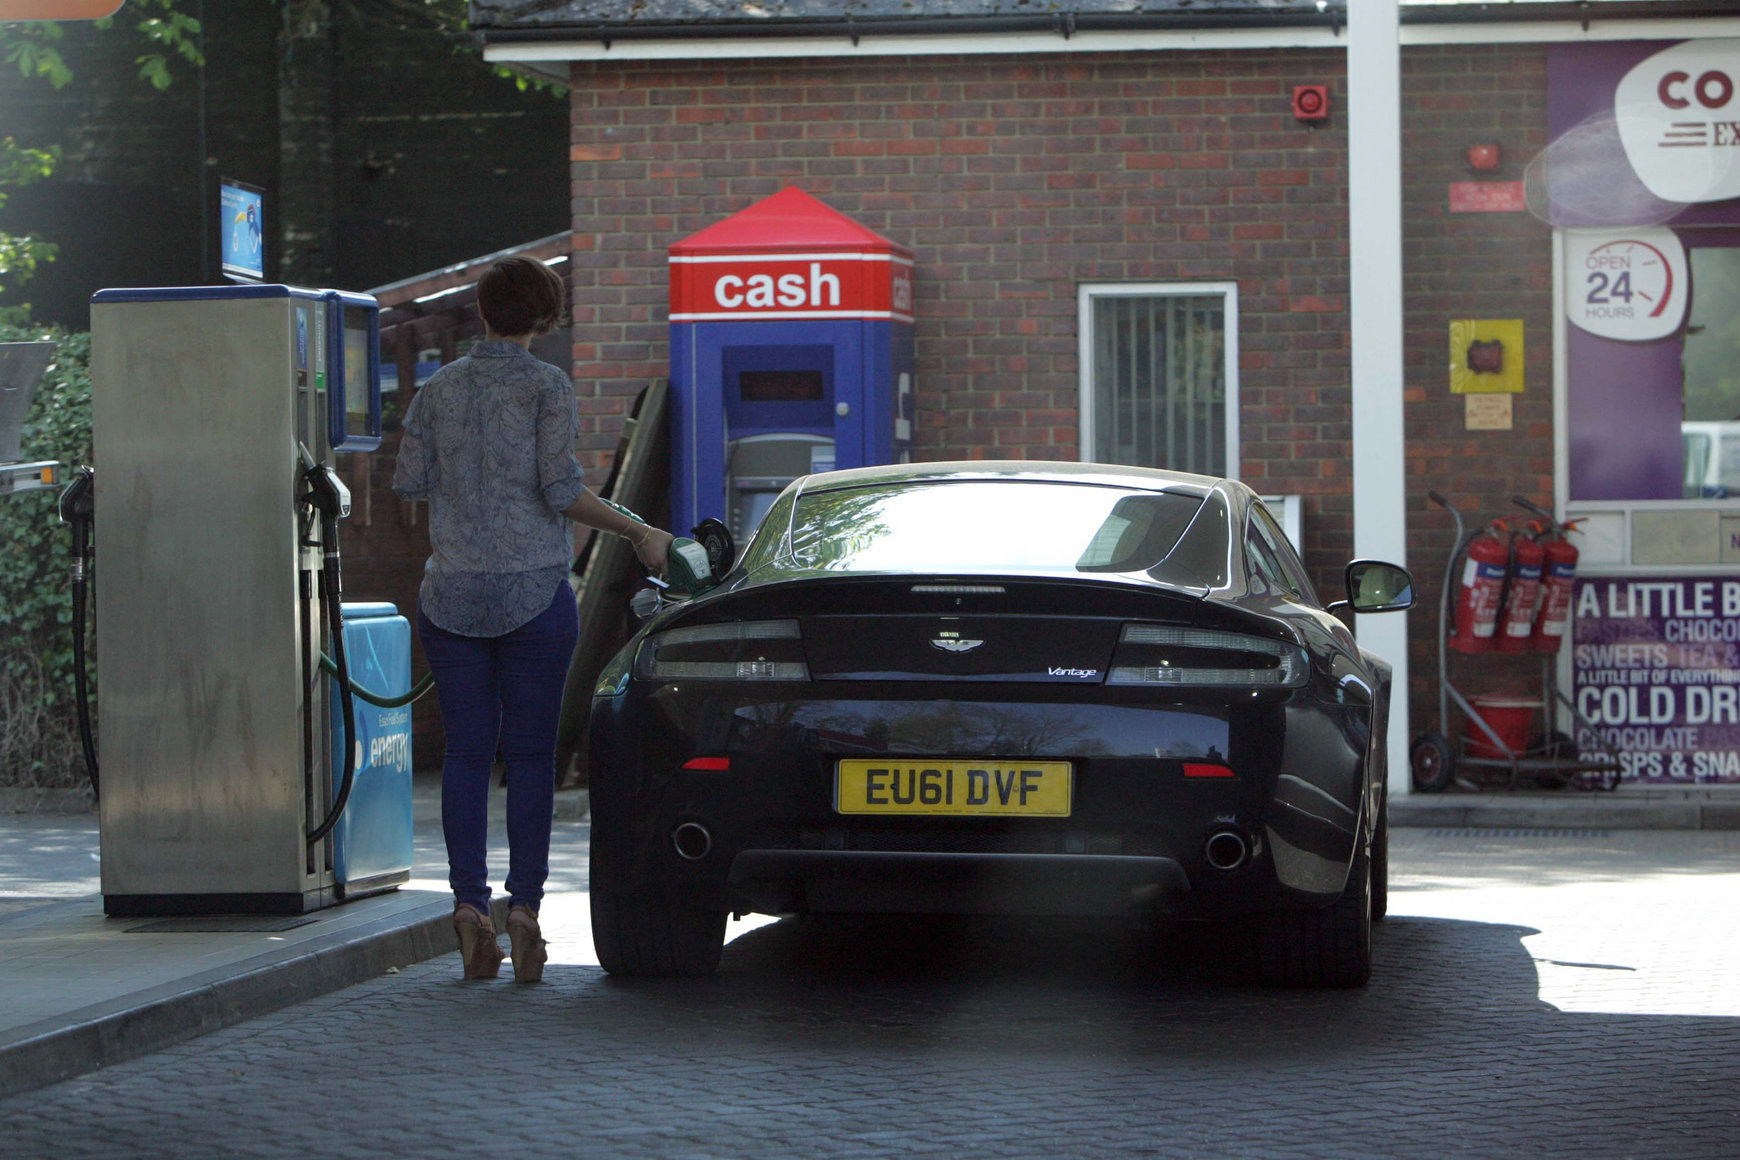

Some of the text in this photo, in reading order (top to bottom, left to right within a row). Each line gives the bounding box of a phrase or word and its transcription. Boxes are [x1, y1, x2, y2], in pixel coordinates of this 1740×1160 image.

[1586, 255, 1631, 270] OPEN
[714, 263, 840, 308] cash
[1586, 271, 1633, 304] 24
[1586, 306, 1634, 319] HOURS
[1577, 583, 1600, 618] A
[1608, 582, 1714, 618] LITTLE
[1665, 619, 1740, 642] CHOCO
[1576, 644, 1668, 669] SWEETS
[1678, 645, 1719, 668] TEA
[1048, 667, 1097, 678] Vantage
[1577, 671, 1586, 685] A
[1588, 670, 1628, 685] LITTLE
[1630, 670, 1650, 684] BIT
[1652, 670, 1669, 684] OF
[1577, 686, 1740, 725] COLD DR
[1577, 727, 1698, 751] CHOCOLATE
[371, 733, 408, 772] energy
[1669, 752, 1687, 778] &
[866, 769, 1043, 806] EU61 DVF
